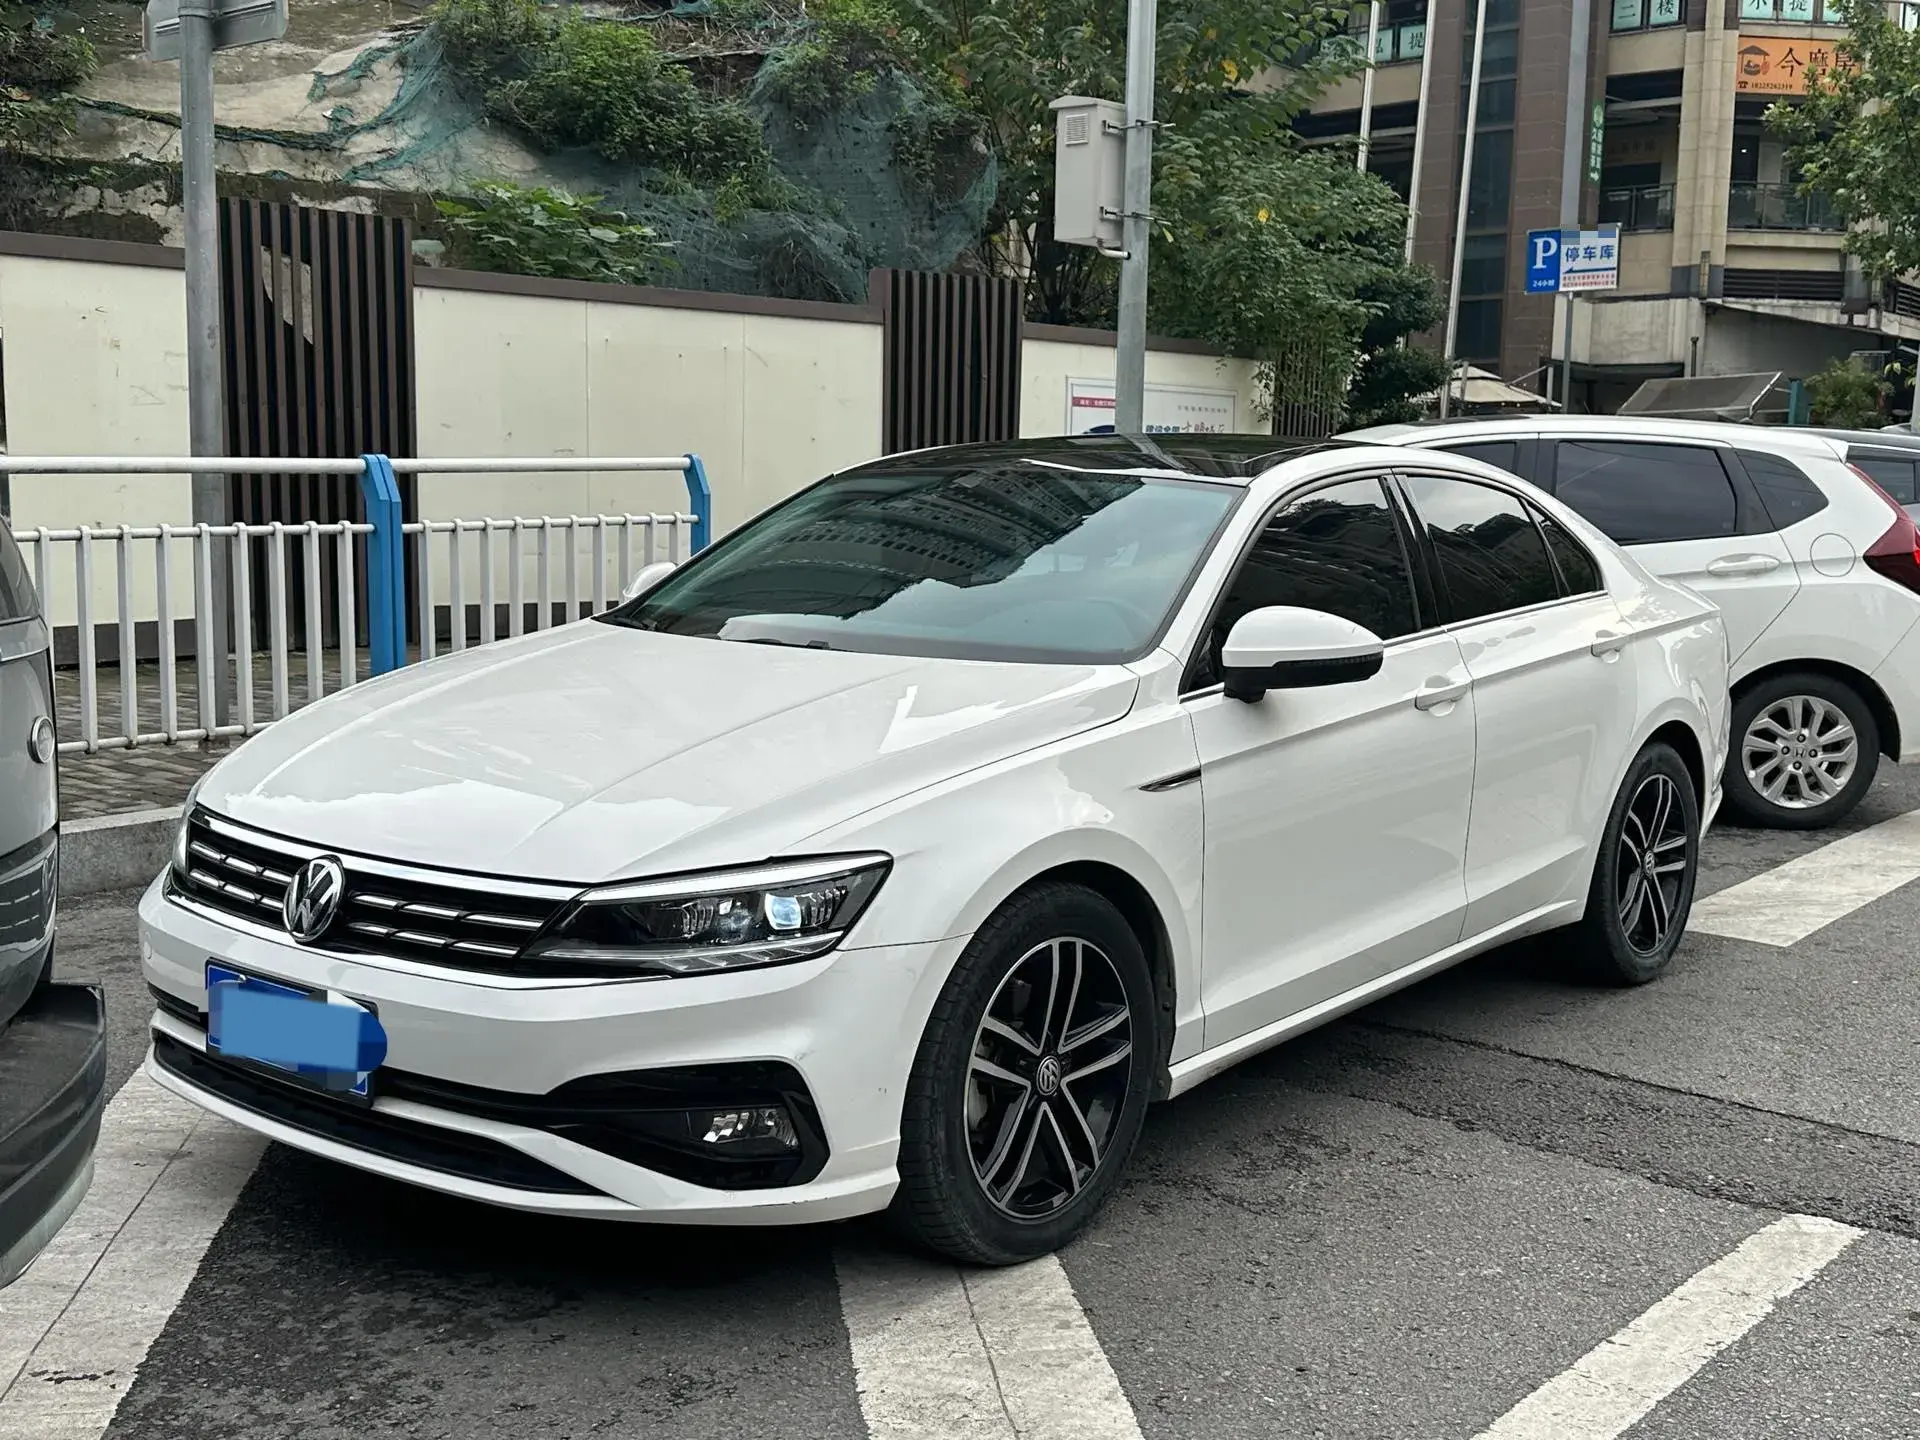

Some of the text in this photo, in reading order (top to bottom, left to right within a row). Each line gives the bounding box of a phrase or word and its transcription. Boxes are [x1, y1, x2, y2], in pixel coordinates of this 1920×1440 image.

[1532, 237, 1558, 269] P
[1566, 244, 1615, 263] 停车库
[1532, 278, 1556, 288] 24小时
